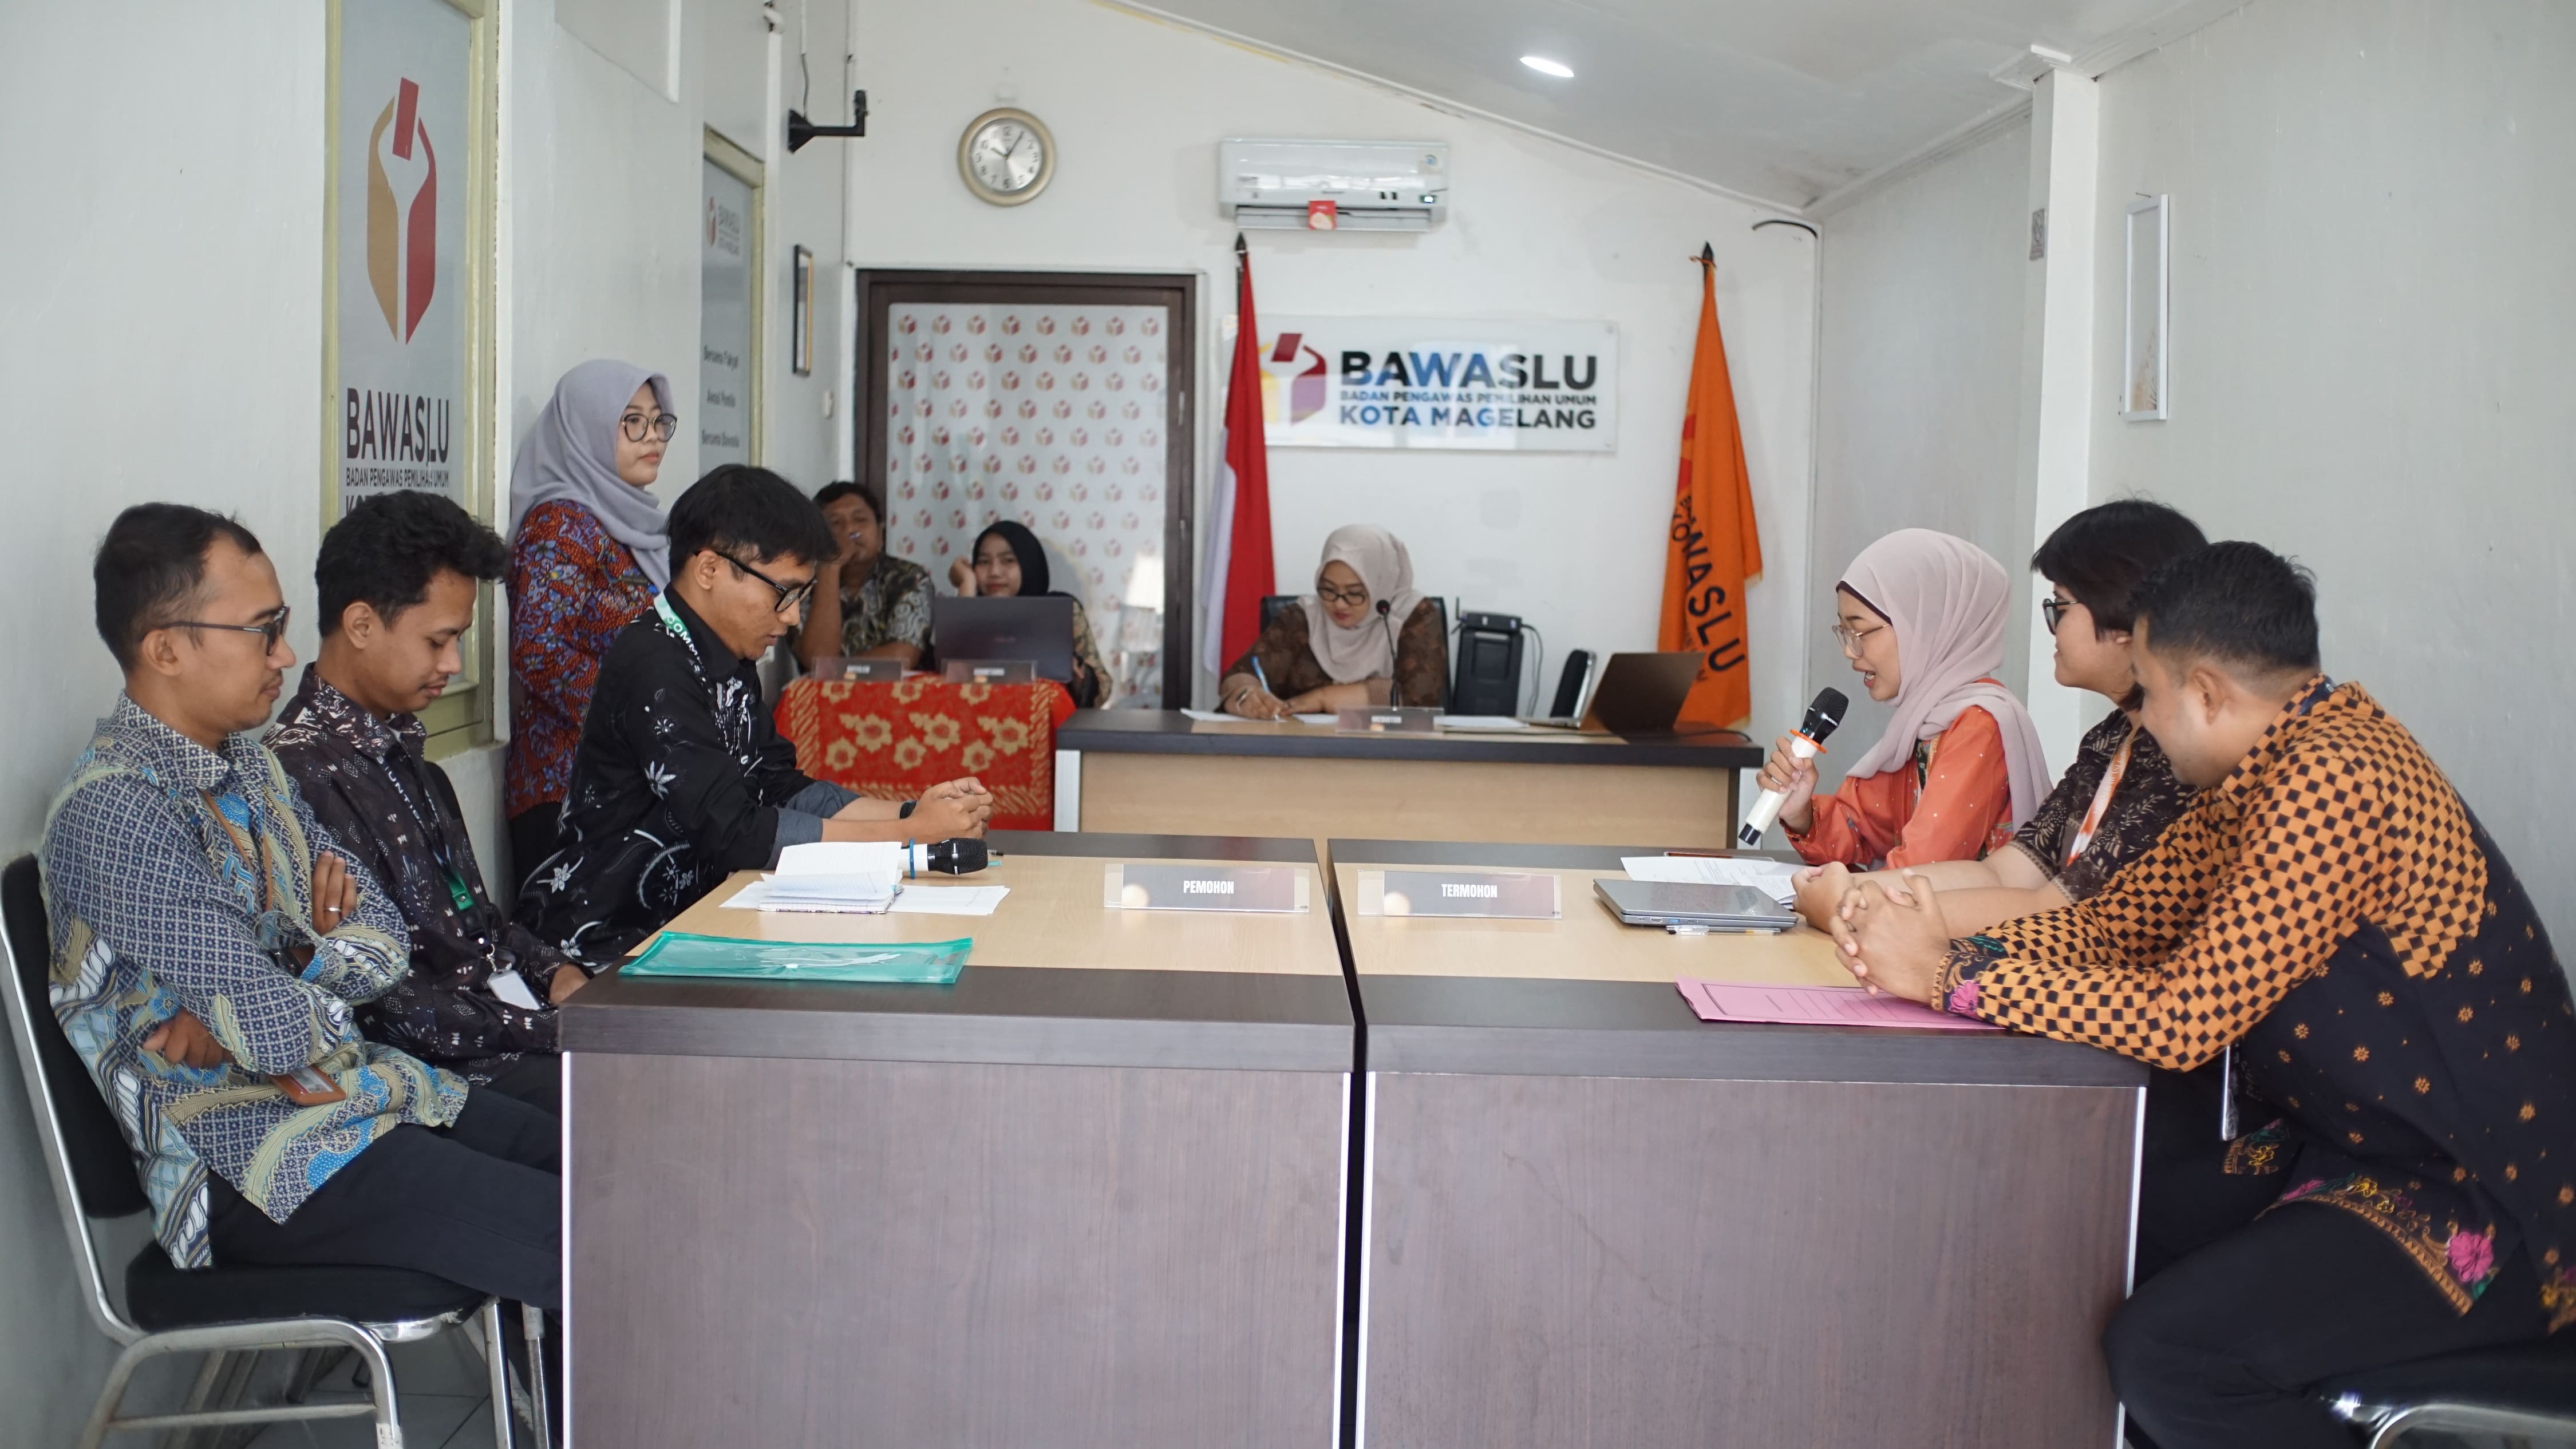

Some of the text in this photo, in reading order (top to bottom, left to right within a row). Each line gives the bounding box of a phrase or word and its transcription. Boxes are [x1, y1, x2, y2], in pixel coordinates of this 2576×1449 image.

[1341, 351, 1597, 390] BAWASLU
[1340, 391, 1389, 400] BADAN
[1394, 391, 1472, 402] PENGAWAS
[1555, 395, 1597, 405] UMUM
[346, 387, 449, 463] BAWASLU
[1340, 405, 1595, 429] KOTA MAGELANG
[346, 467, 368, 486] BADAN
[370, 468, 402, 487] PENGAWAS
[433, 470, 449, 488] UMUM
[1183, 880, 1234, 894] PEMOHON
[1441, 884, 1498, 898] TERMOHON
